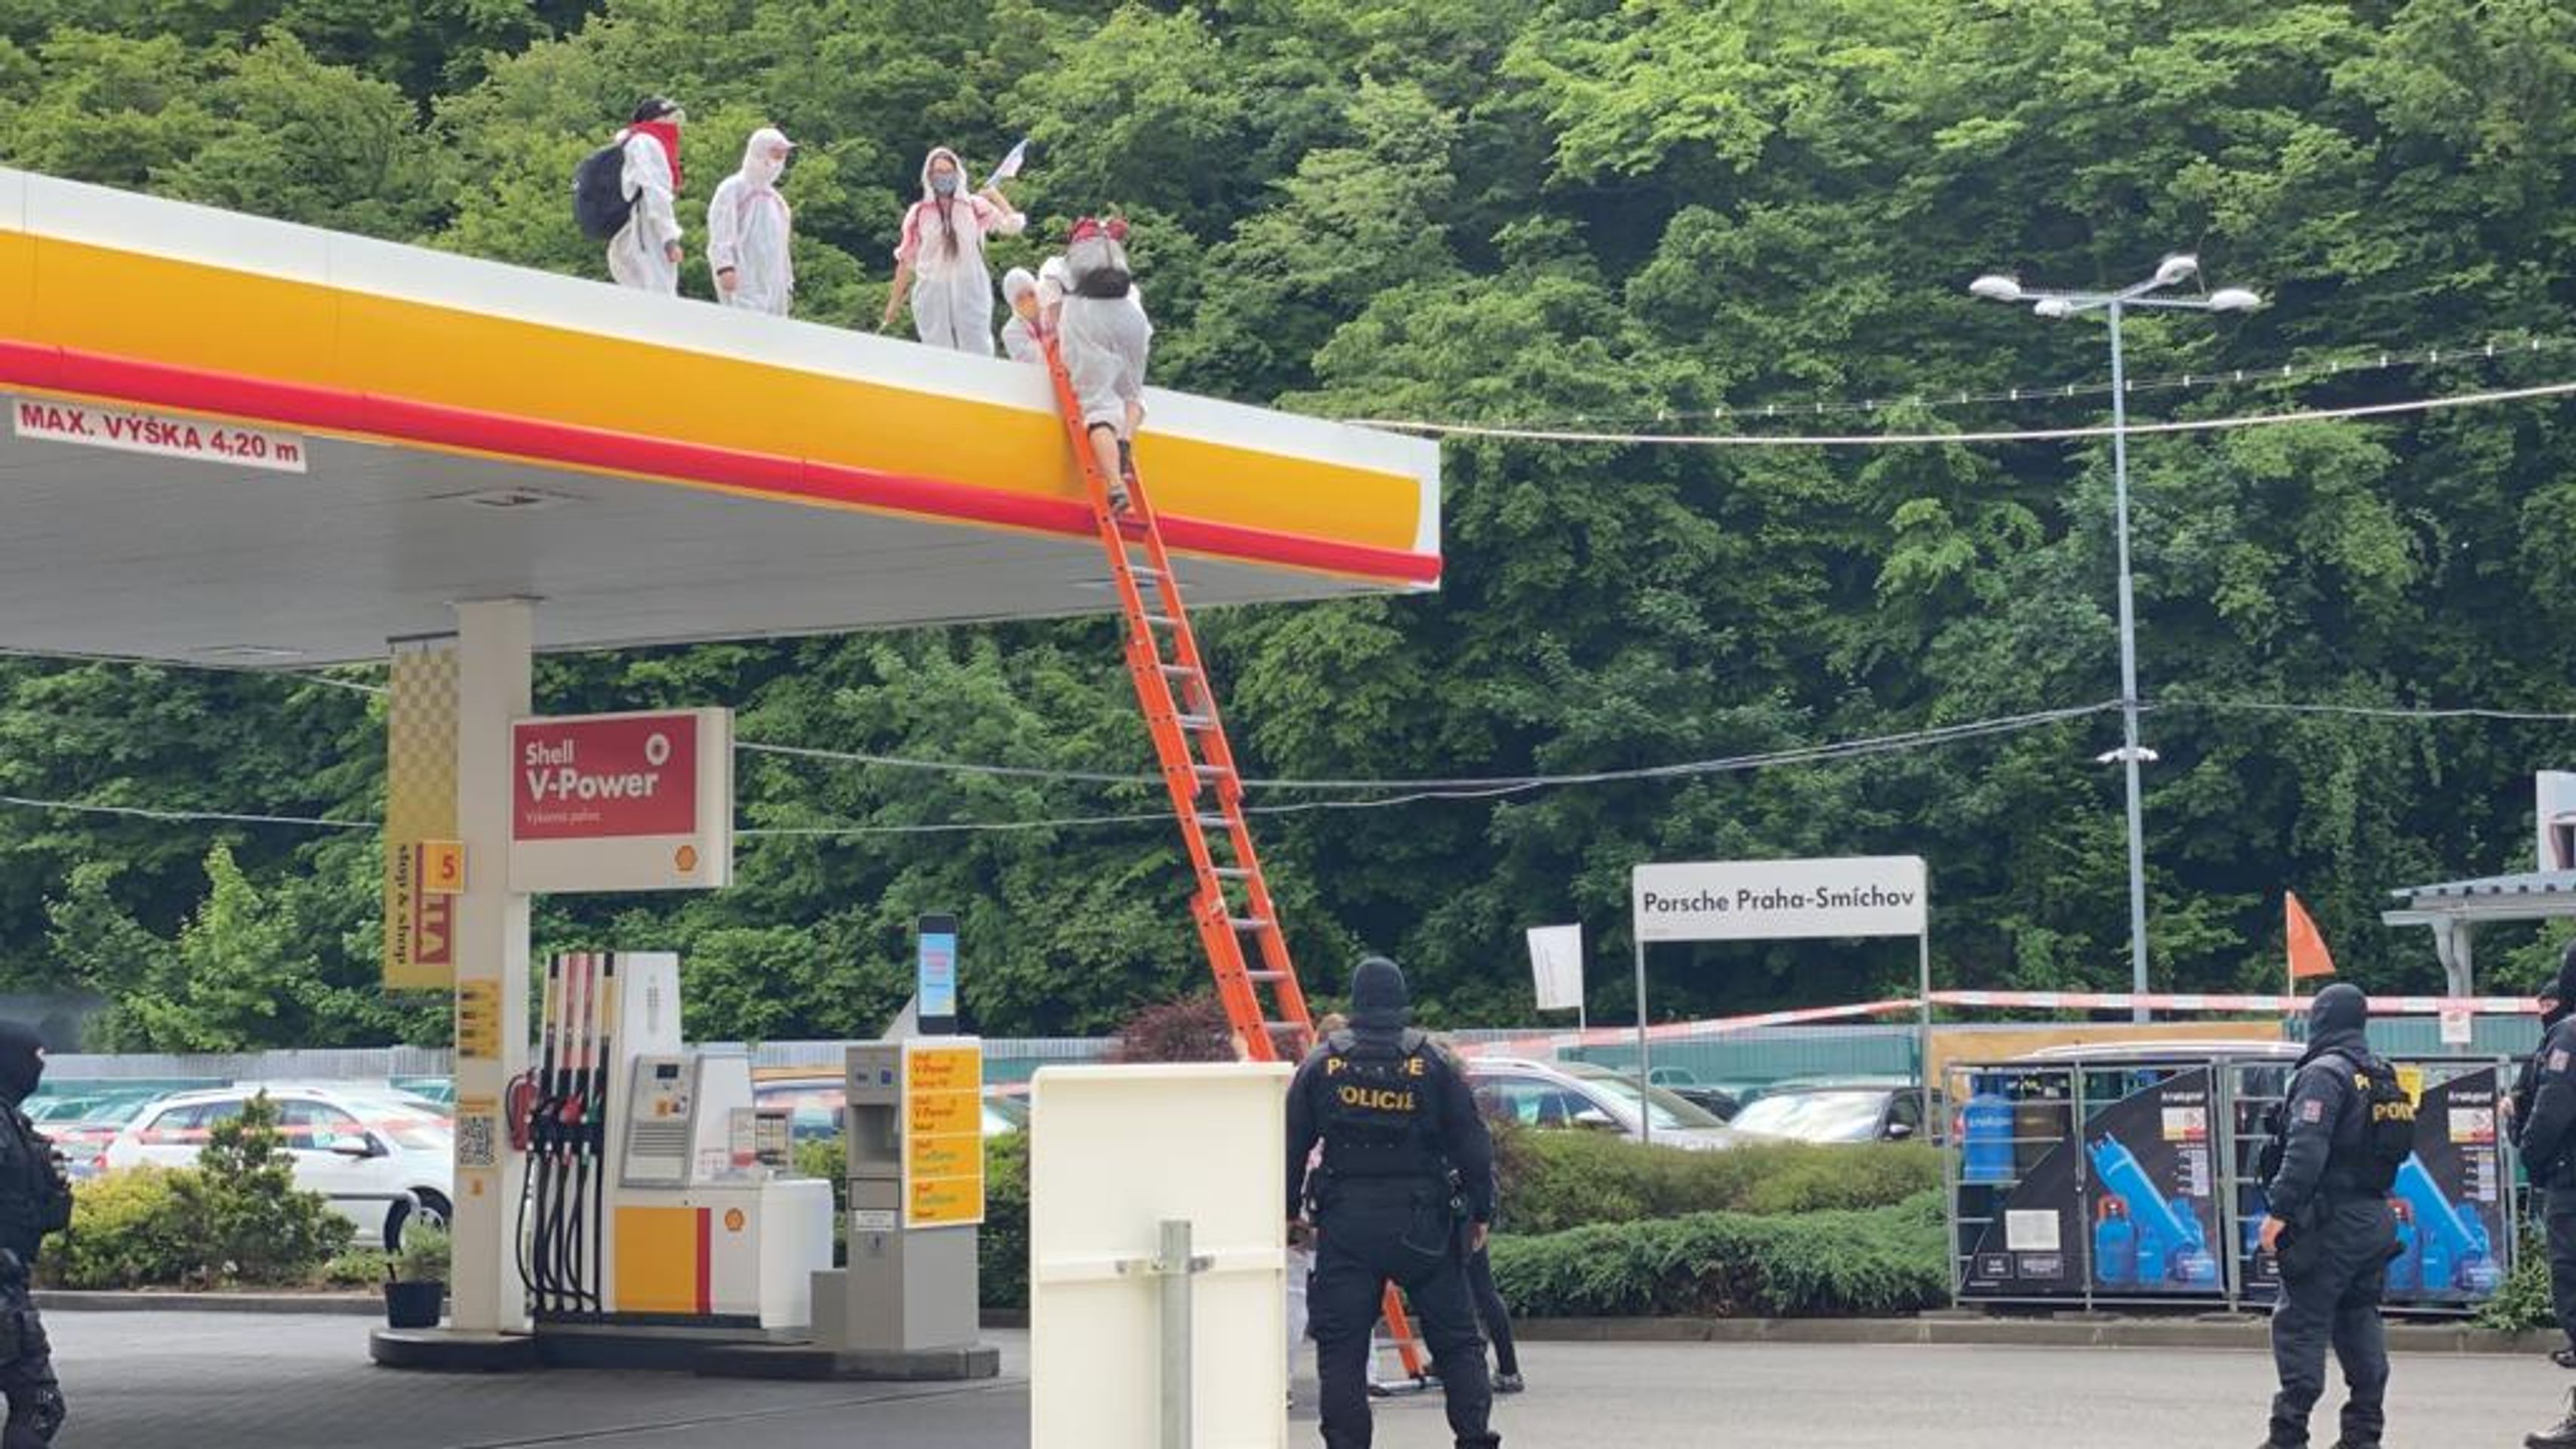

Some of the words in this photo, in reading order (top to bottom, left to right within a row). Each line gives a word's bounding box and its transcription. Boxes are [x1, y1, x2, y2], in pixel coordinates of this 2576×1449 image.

[20, 403, 94, 436] MAX.
[103, 414, 202, 451] VÝŠKA
[211, 429, 266, 458] 4,20
[275, 443, 299, 463] m
[525, 739, 574, 766] Shell
[526, 768, 658, 801] V-Power
[442, 854, 456, 879] 5
[1644, 891, 1729, 912] Porsche
[1737, 884, 1914, 910] Praha-Smíchov
[420, 894, 445, 957] LLA
[1337, 1085, 1416, 1110] OLICIE
